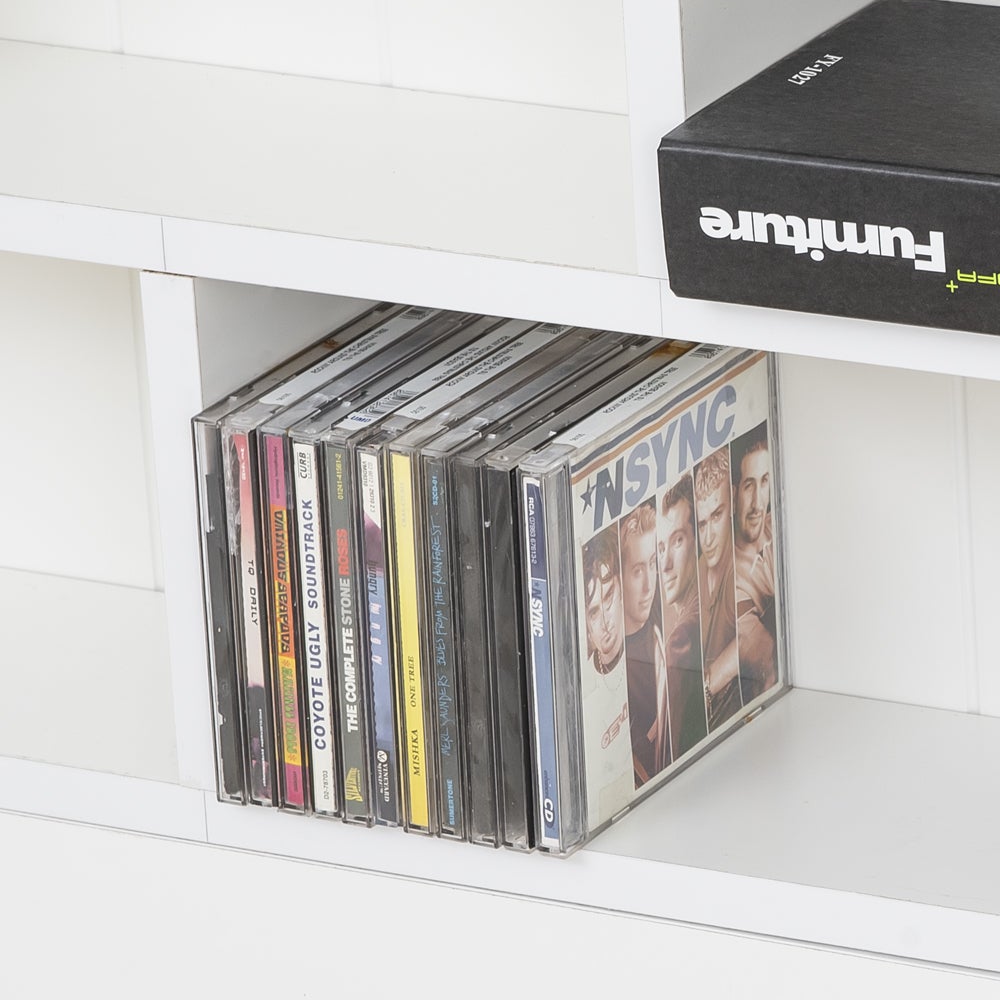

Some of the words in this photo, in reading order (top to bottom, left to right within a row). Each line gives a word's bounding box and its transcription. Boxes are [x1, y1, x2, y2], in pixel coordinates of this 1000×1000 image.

[787, 53, 844, 86] FY-1027
[699, 207, 947, 273] Furniture
[298, 452, 308, 479] CURB
[301, 500, 319, 609] SOUNDTRACK
[336, 528, 350, 577] ROSES
[431, 515, 447, 585] RAINFOREST
[249, 587, 259, 626] DAILY
[339, 577, 353, 626] STONE
[433, 586, 446, 609] THE
[307, 622, 323, 670] UGLY
[342, 627, 357, 704] COMPLETE
[407, 656, 415, 682] TREE
[311, 677, 327, 750] COYOTE
[347, 704, 359, 733] THE
[408, 729, 420, 776] MISHKA
[544, 798, 554, 823] CD
